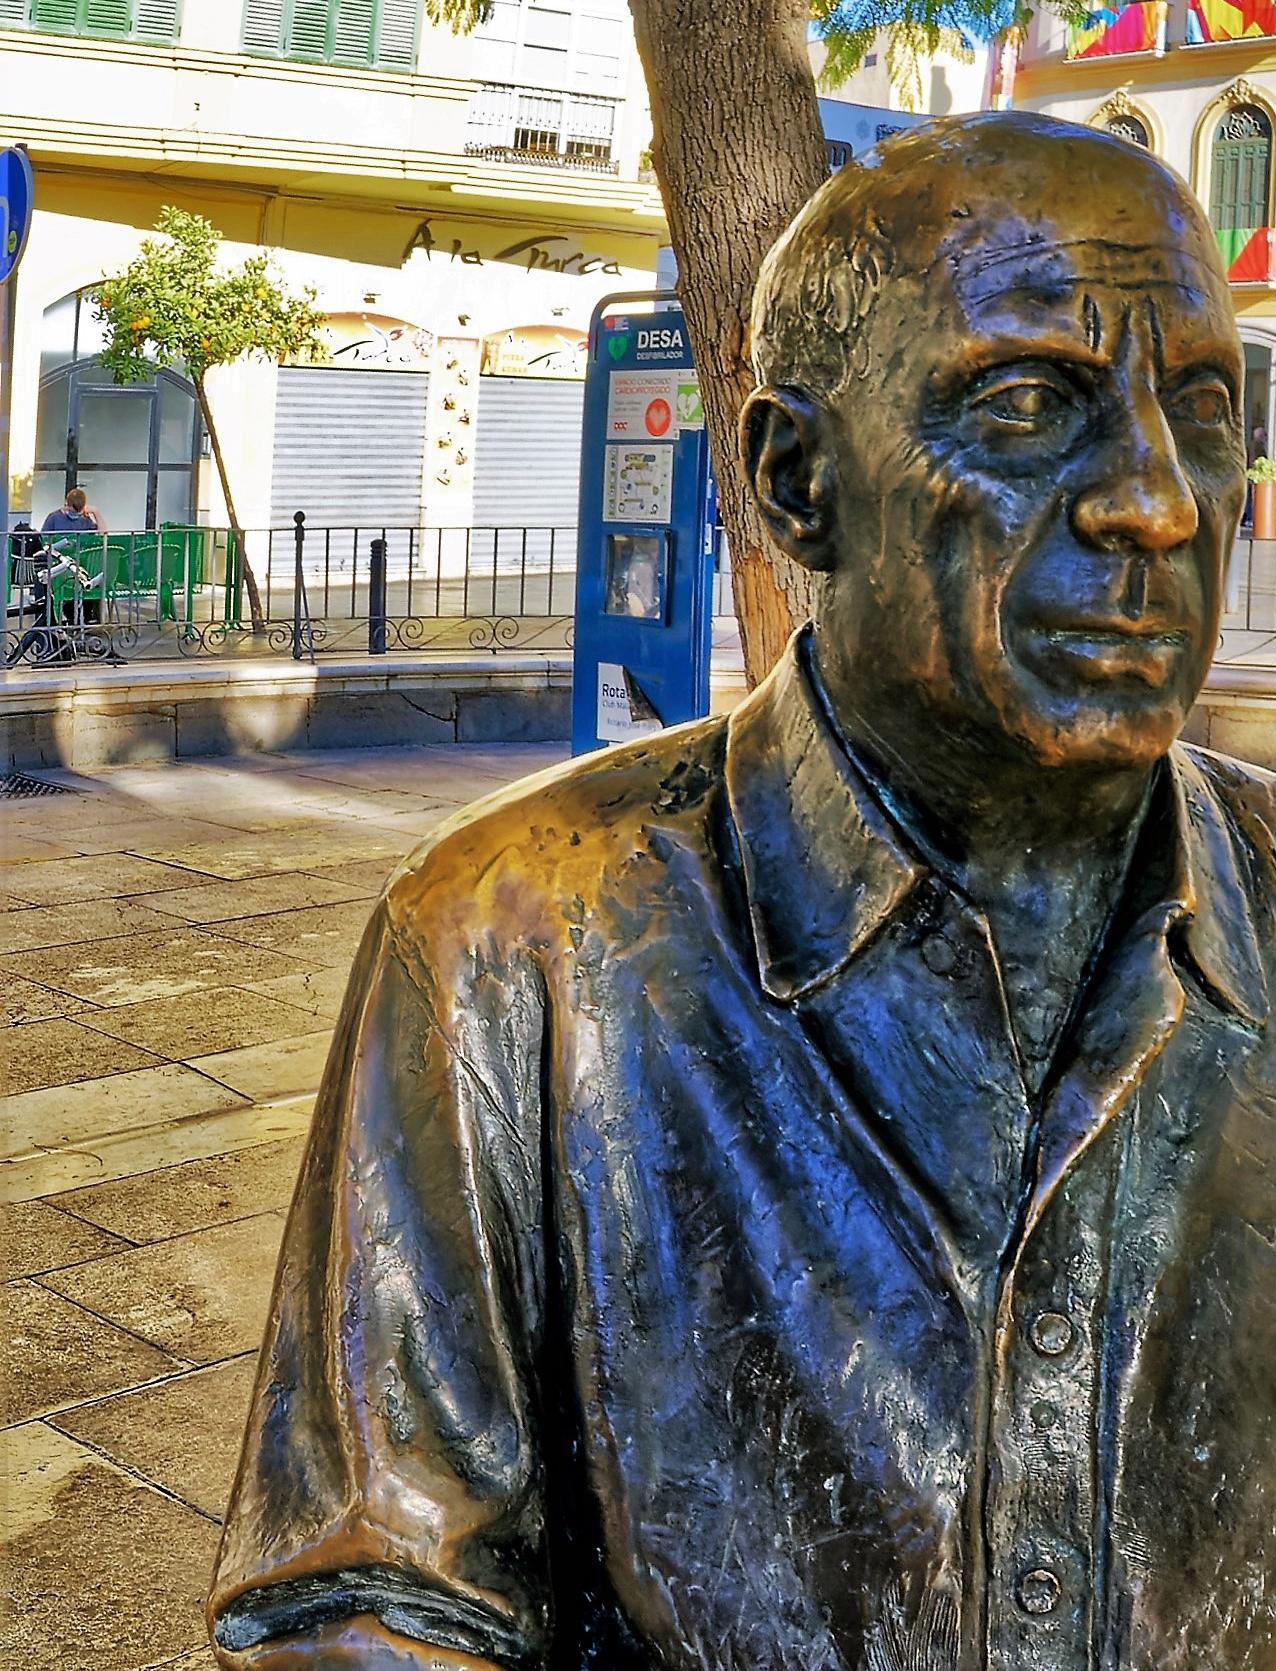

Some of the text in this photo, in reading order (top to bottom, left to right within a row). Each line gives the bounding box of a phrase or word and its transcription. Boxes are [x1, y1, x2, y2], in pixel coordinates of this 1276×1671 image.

[402, 218, 623, 276] A la Turca
[637, 329, 684, 349] DESA
[602, 683, 627, 699] Rota
